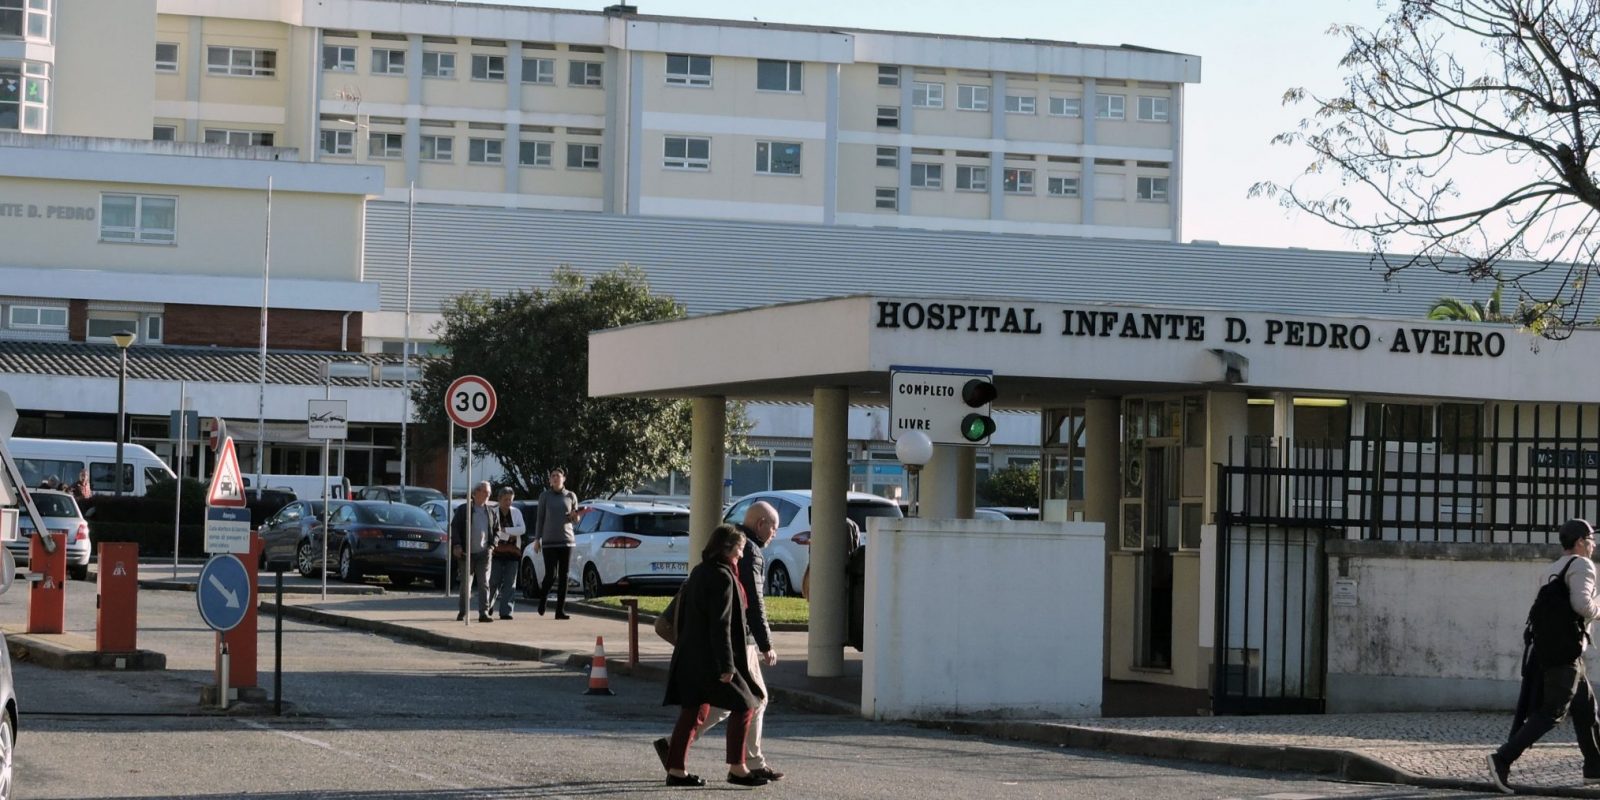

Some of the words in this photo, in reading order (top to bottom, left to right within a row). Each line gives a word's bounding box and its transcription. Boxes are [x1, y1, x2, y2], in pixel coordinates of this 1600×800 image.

[27, 204, 42, 219] D.
[46, 205, 96, 221] PEDRO
[876, 301, 1042, 334] HOSPITAL
[1062, 309, 1205, 341] INFANTE
[1224, 317, 1251, 344] D.
[1264, 319, 1371, 350] PEDRO
[1389, 327, 1506, 357] AVEIRO
[899, 383, 955, 397] COMPLETO
[456, 391, 487, 412] 30
[898, 418, 931, 430] LIVRE
